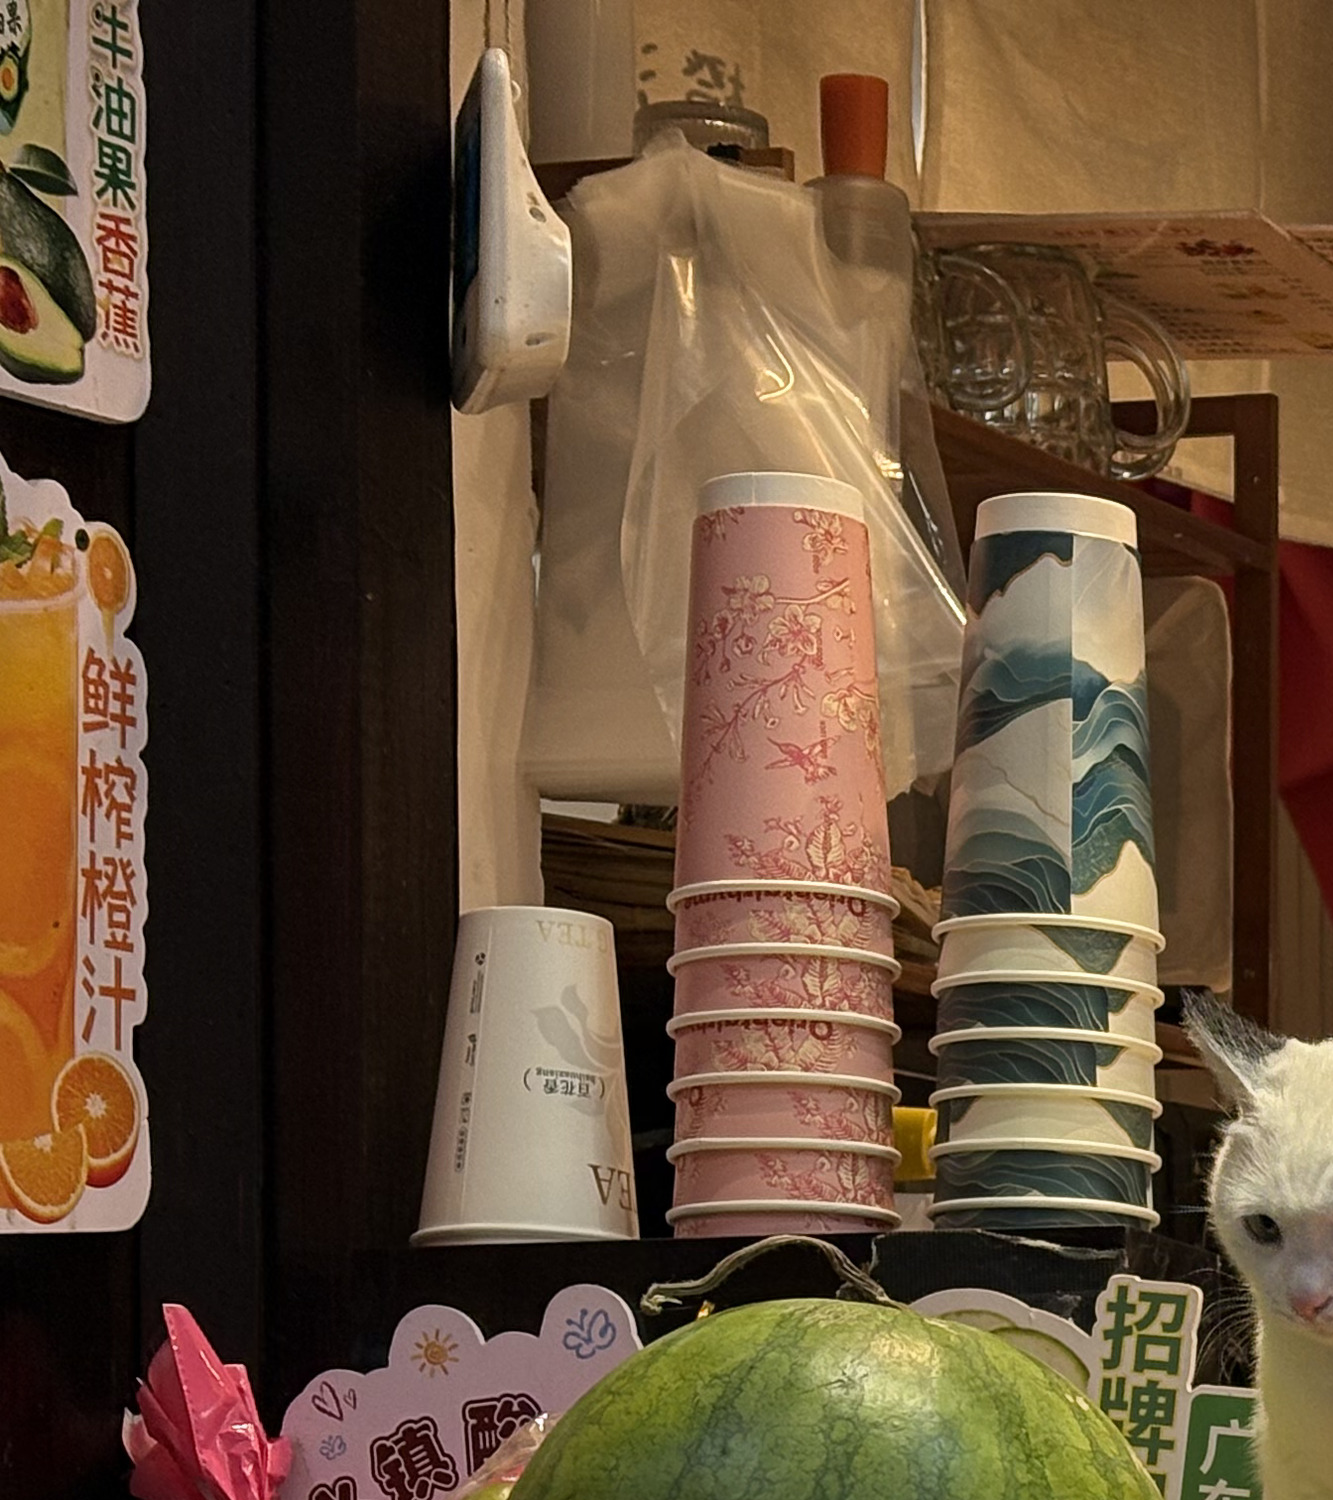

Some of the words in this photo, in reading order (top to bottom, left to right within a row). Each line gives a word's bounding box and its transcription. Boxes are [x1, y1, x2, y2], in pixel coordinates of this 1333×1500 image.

[80, 647, 138, 1051] 鲜榨橙汁
[587, 1163, 637, 1213] EA
[1100, 1284, 1188, 1498] 招牌
